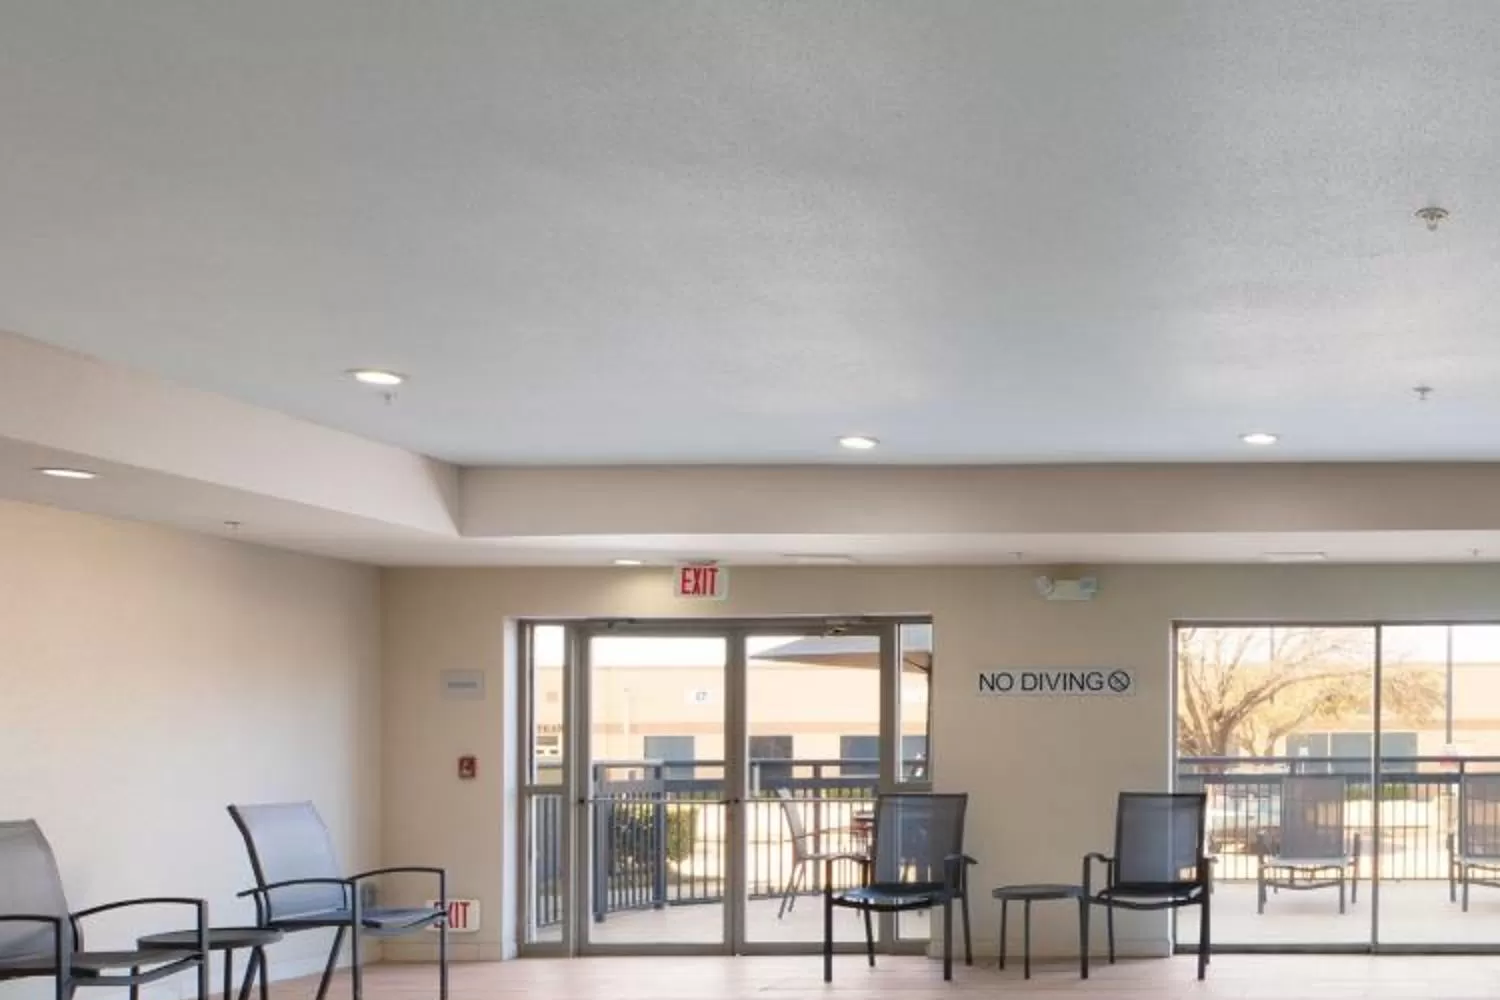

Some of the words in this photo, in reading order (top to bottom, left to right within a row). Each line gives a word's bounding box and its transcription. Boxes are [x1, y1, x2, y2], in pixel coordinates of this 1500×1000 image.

[681, 567, 719, 595] EXIT
[978, 671, 1014, 692] NO
[1020, 671, 1105, 692] DIVING
